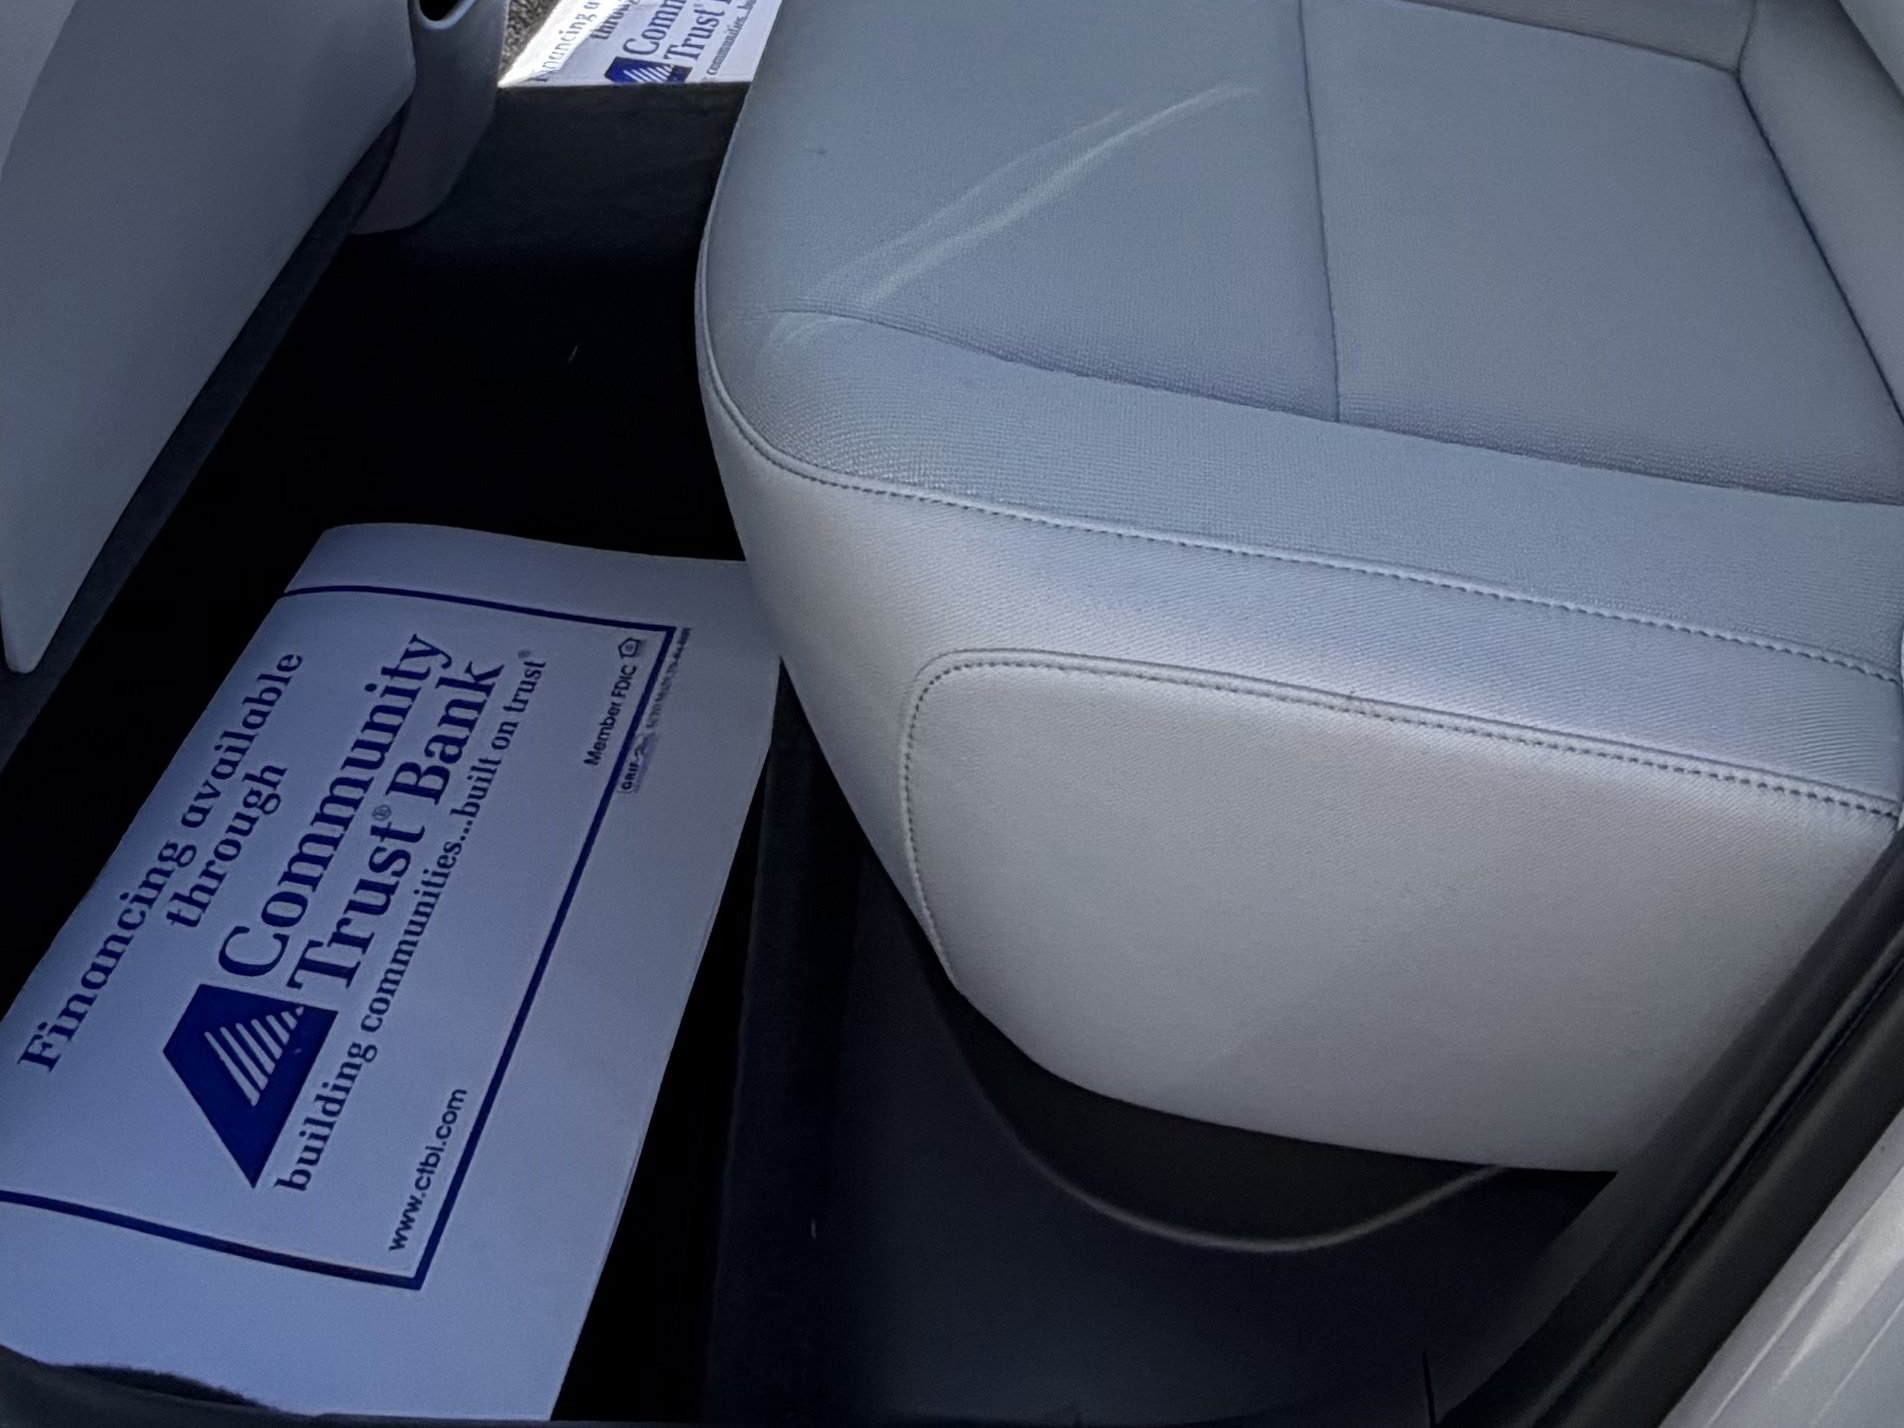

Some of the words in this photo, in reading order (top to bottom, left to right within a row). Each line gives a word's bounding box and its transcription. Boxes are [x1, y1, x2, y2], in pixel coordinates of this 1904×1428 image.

[217, 633, 453, 979] Community
[388, 660, 505, 805] Bank
[583, 701, 624, 766] Member
[610, 664, 638, 699] FDIC
[17, 839, 197, 1072] Financing
[181, 651, 305, 830] available
[166, 761, 288, 929] through
[274, 1040, 378, 1192] building
[491, 707, 516, 752] on
